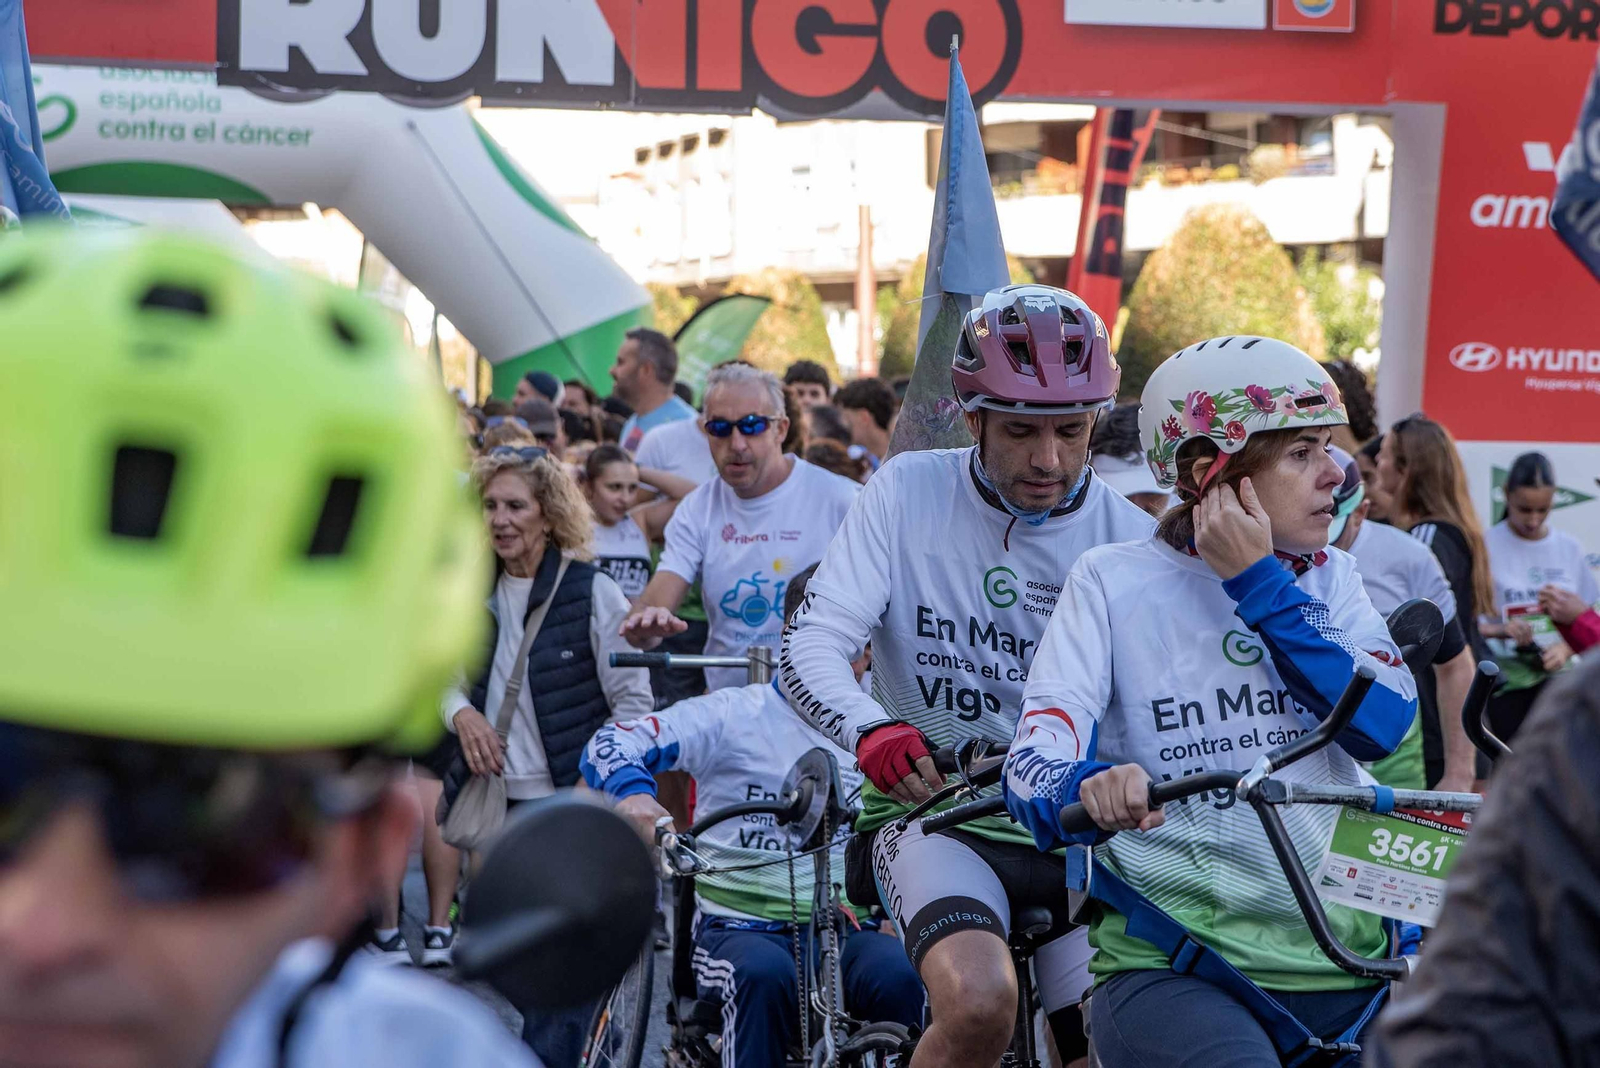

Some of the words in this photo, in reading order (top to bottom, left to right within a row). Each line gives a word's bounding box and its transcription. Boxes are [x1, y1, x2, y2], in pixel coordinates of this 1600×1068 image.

[99, 66, 217, 83] asociaci
[99, 119, 185, 141] contra
[193, 120, 216, 142] el
[223, 121, 314, 147] cáncer
[1470, 194, 1551, 229] am
[1025, 592, 1058, 606] españ
[917, 605, 956, 643] En
[969, 616, 1039, 660] Mar
[916, 652, 976, 674] contra
[981, 663, 1001, 681] el
[916, 675, 1001, 721] Vigo
[1151, 697, 1205, 732] En
[1160, 737, 1233, 762] contra
[1239, 729, 1262, 749] el
[742, 814, 775, 827] cont
[1416, 817, 1442, 831] contra
[1368, 828, 1449, 872] 3561
[919, 911, 992, 940] Santiago
